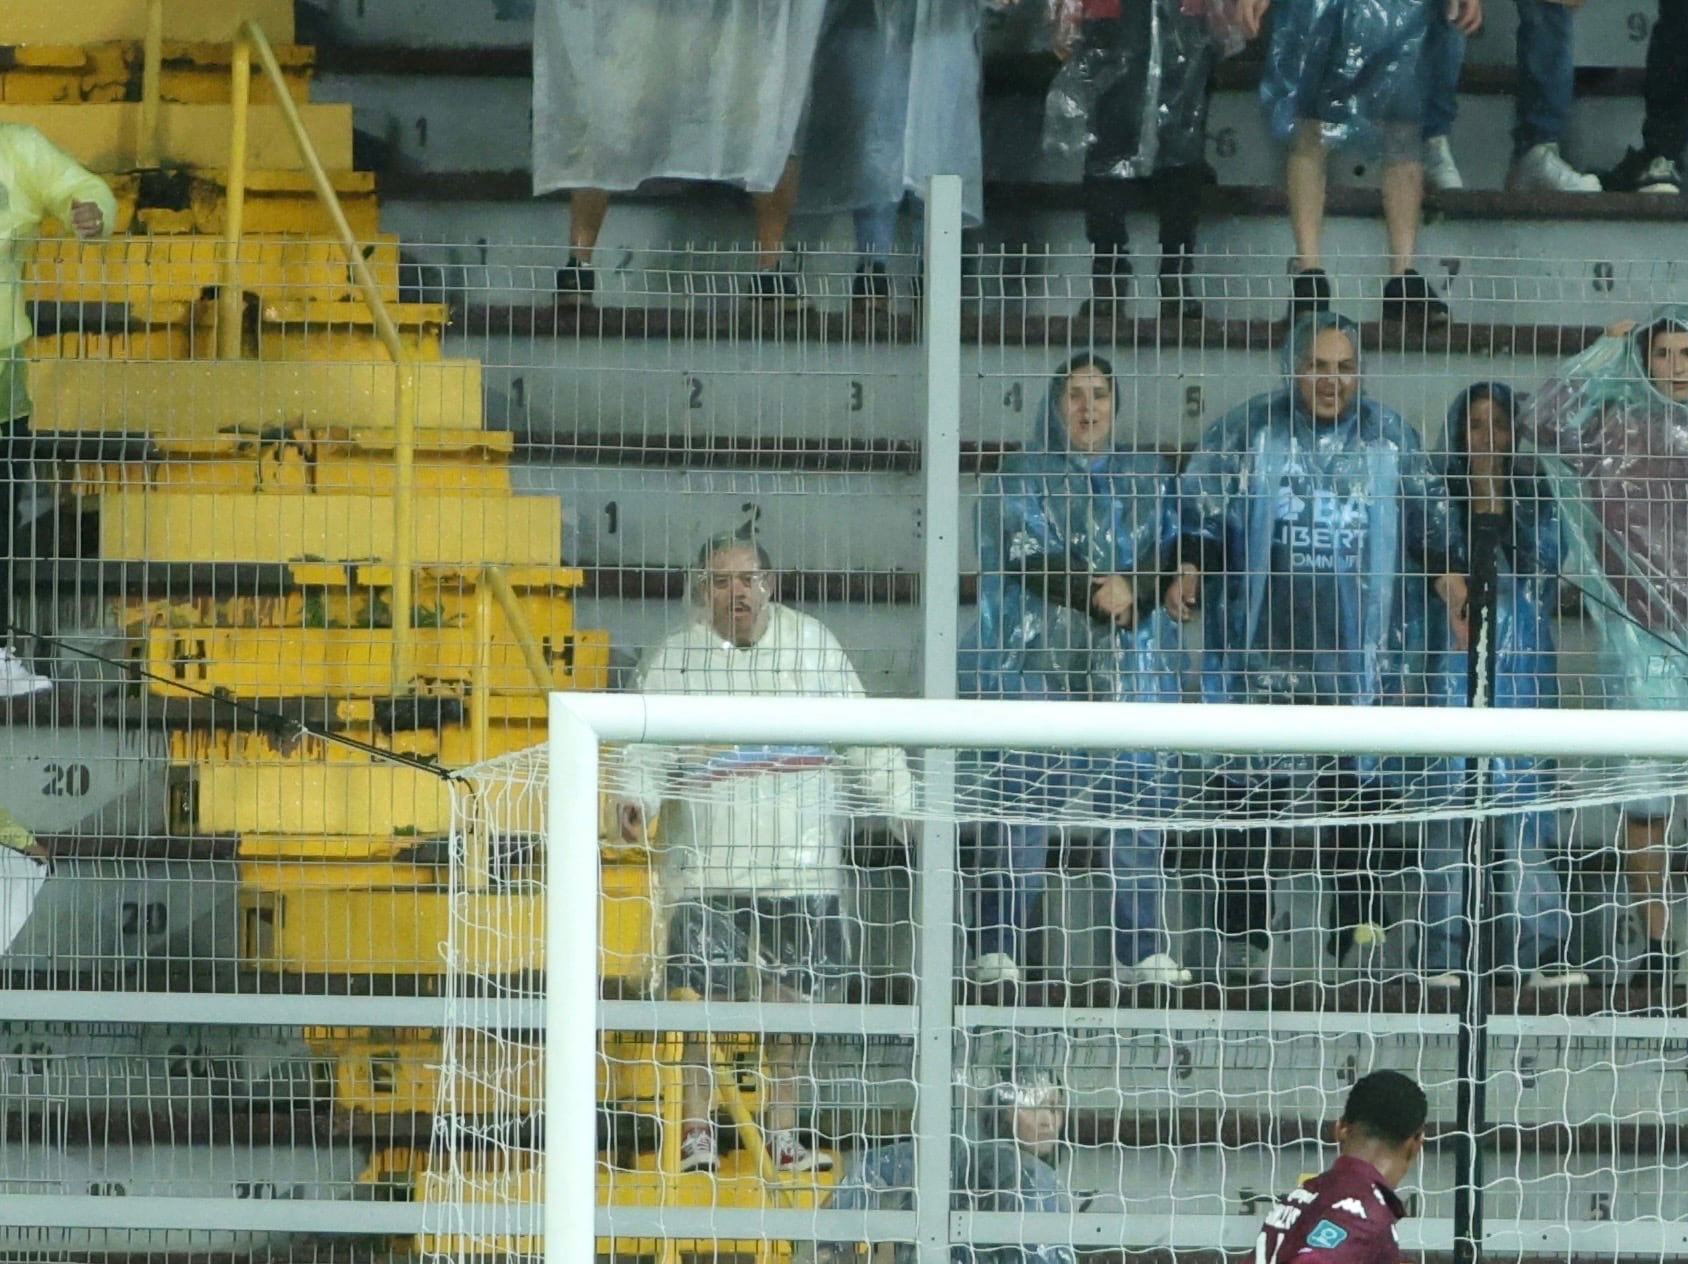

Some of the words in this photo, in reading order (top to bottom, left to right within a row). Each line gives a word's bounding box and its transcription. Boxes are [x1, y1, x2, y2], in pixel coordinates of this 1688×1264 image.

[1627, 12, 1648, 42] 9
[511, 377, 524, 407] 1
[687, 377, 703, 409] 2
[849, 381, 864, 411] 3
[604, 501, 618, 534] 1
[173, 638, 207, 680] H
[41, 762, 90, 798] 20
